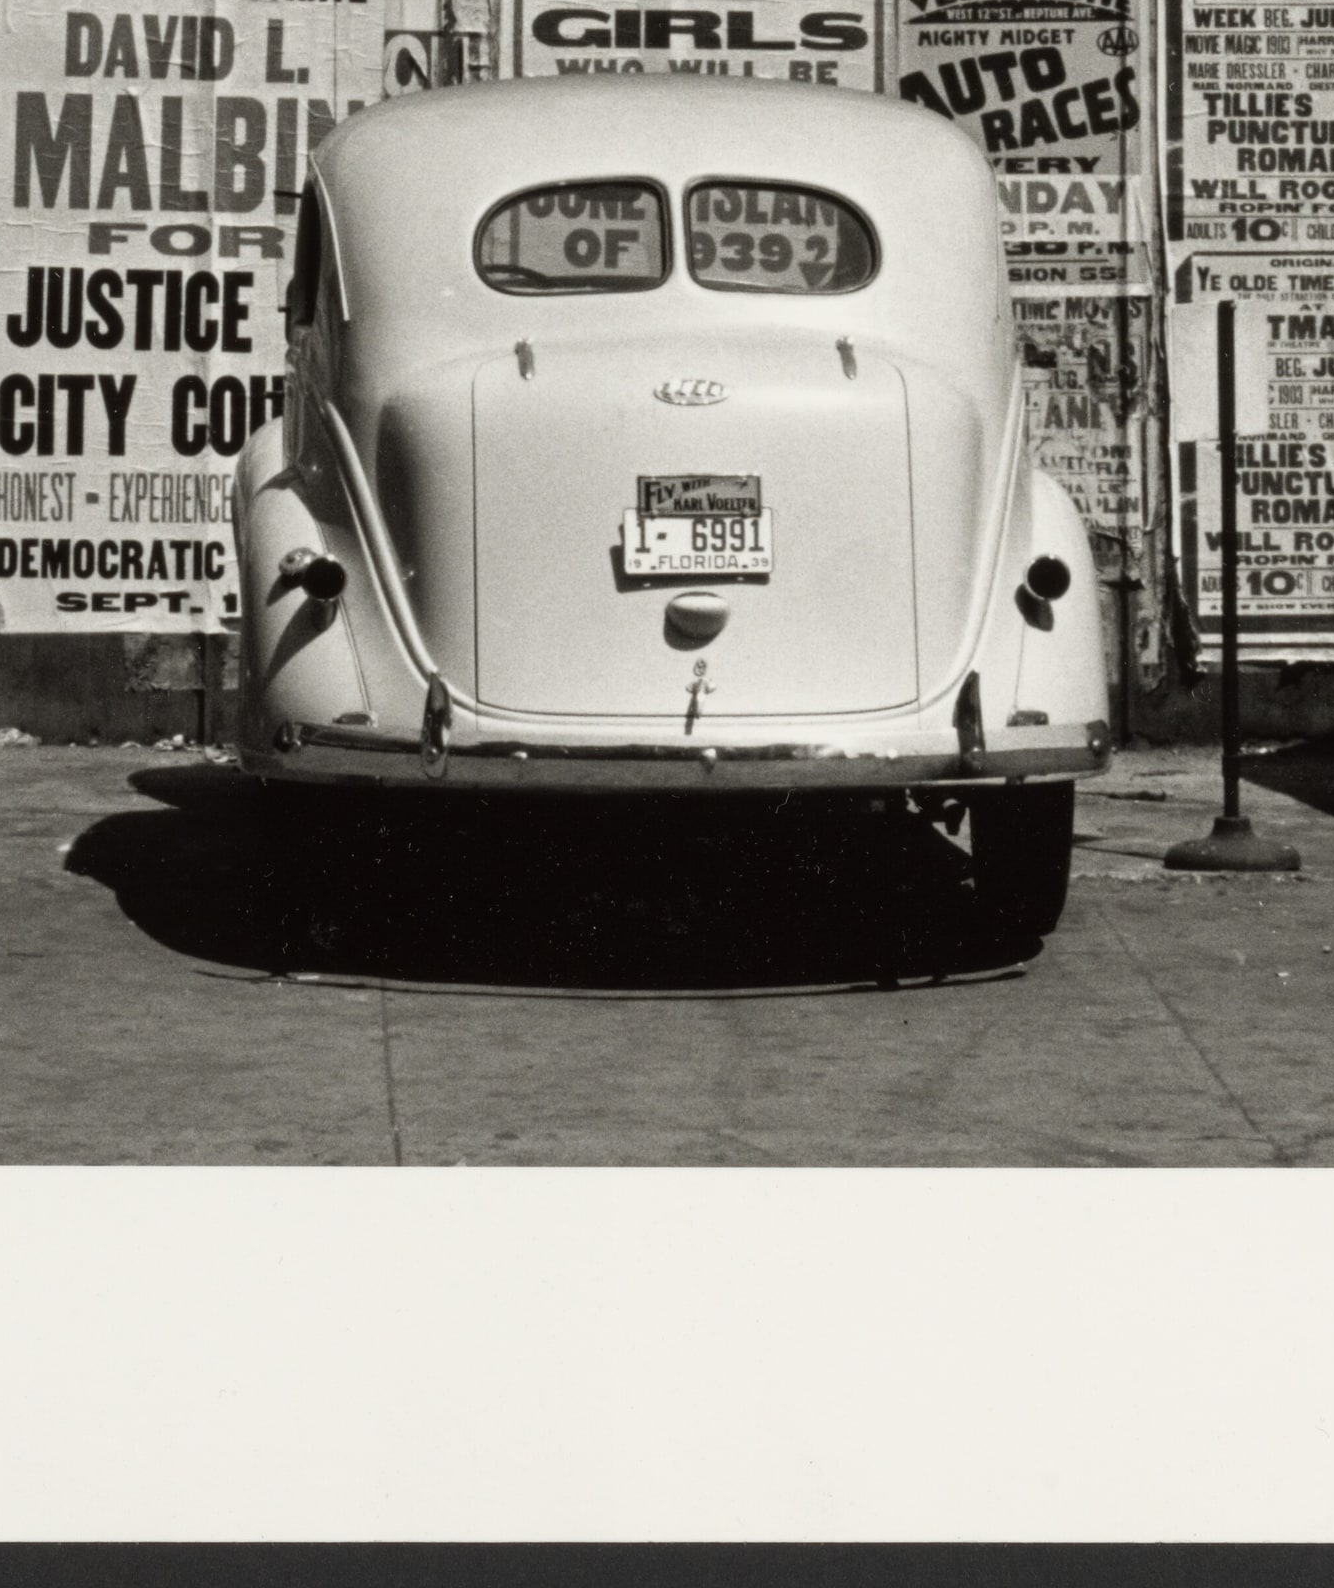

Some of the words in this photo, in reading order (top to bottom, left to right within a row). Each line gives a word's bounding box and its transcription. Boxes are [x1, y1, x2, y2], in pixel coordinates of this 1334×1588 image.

[1193, 8, 1257, 28] WEEK
[1263, 7, 1294, 28] BEG.
[531, 8, 869, 51] GIRLS
[917, 29, 990, 47] MIGHTY
[999, 28, 1076, 46] MIDGET
[64, 11, 235, 81] DAVID
[266, 18, 310, 84] L.
[1185, 34, 1220, 55] MOVIE
[1224, 34, 1262, 55] MAGIC
[788, 60, 839, 87] BE
[1187, 62, 1220, 80] MARIE
[1226, 62, 1286, 80] DRESSLER
[898, 46, 1067, 121] AUTO
[980, 66, 1141, 153] RACES
[1202, 92, 1313, 118] TILLIE'S
[1190, 178, 1268, 200] WILL
[88, 222, 286, 259] FOR
[1186, 222, 1227, 240] ADULTS
[563, 227, 640, 269] OF
[1229, 275, 1278, 292] OLDE
[1287, 275, 1334, 292] TIME
[6, 266, 254, 353] JUSTICE
[1275, 357, 1307, 378] BEG.
[1278, 385, 1304, 405] 1903
[1217, 442, 1327, 468] ILLIE'S
[681, 478, 711, 493] WITH
[658, 555, 739, 570] FLORIDA
[751, 557, 770, 568] 39
[1200, 575, 1241, 593] ADUS
[56, 591, 204, 613] SEPT.
